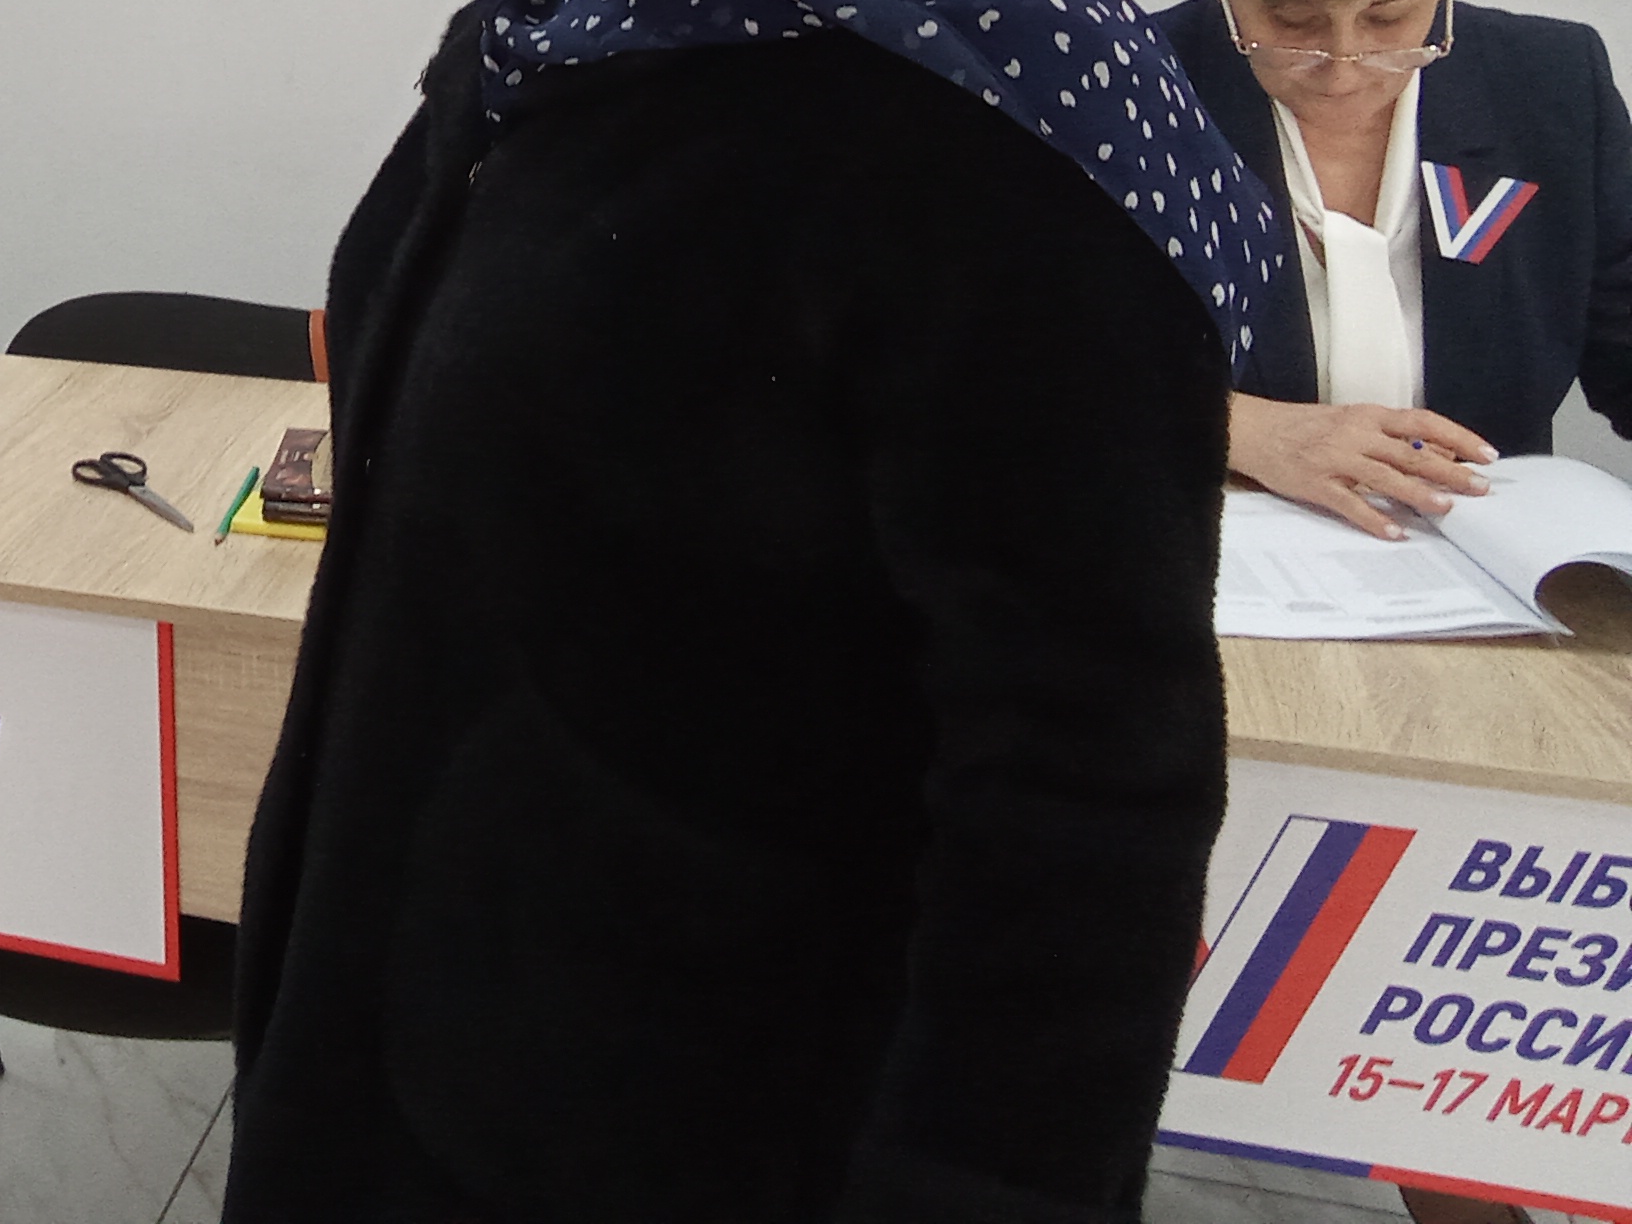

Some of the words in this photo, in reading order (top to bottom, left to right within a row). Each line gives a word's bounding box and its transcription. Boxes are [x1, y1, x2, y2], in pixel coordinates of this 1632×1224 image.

[1448, 838, 1632, 911] ВЫБ
[1359, 984, 1632, 1075] РОССИ
[1486, 1077, 1632, 1144] МАР
